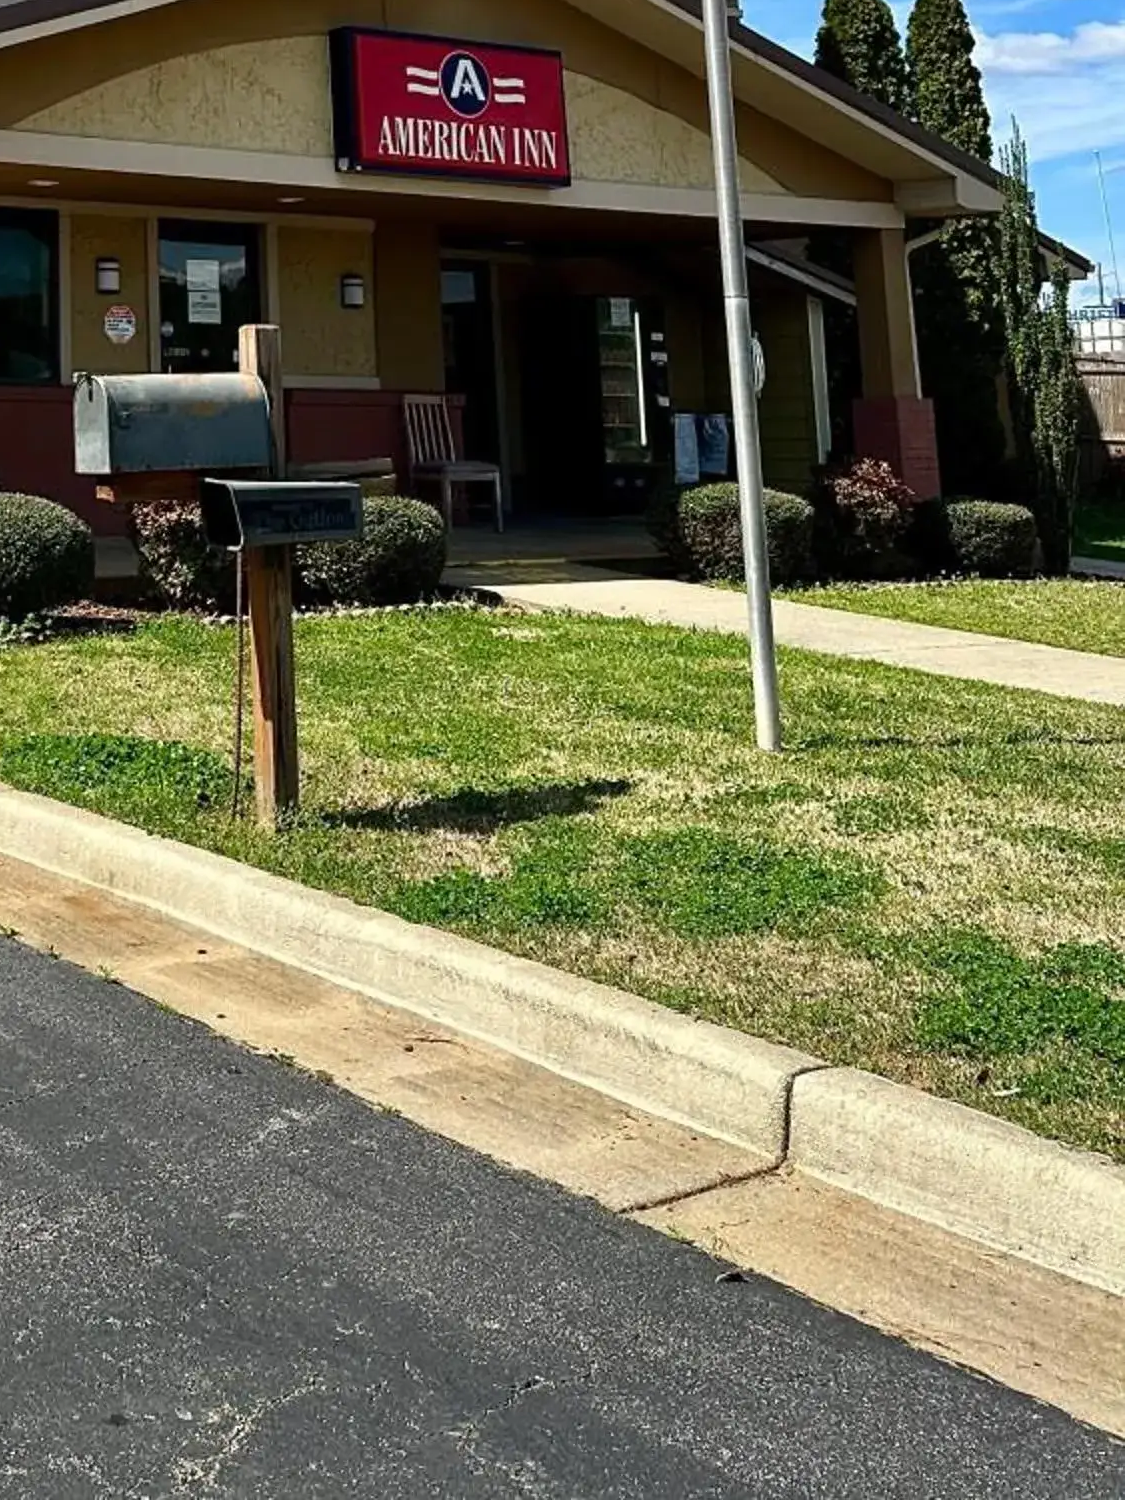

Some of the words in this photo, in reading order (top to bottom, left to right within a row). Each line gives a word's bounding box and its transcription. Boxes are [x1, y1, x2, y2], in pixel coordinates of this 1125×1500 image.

[450, 59, 486, 101] A
[378, 116, 505, 165] AMERICAN
[513, 127, 557, 169] INN
